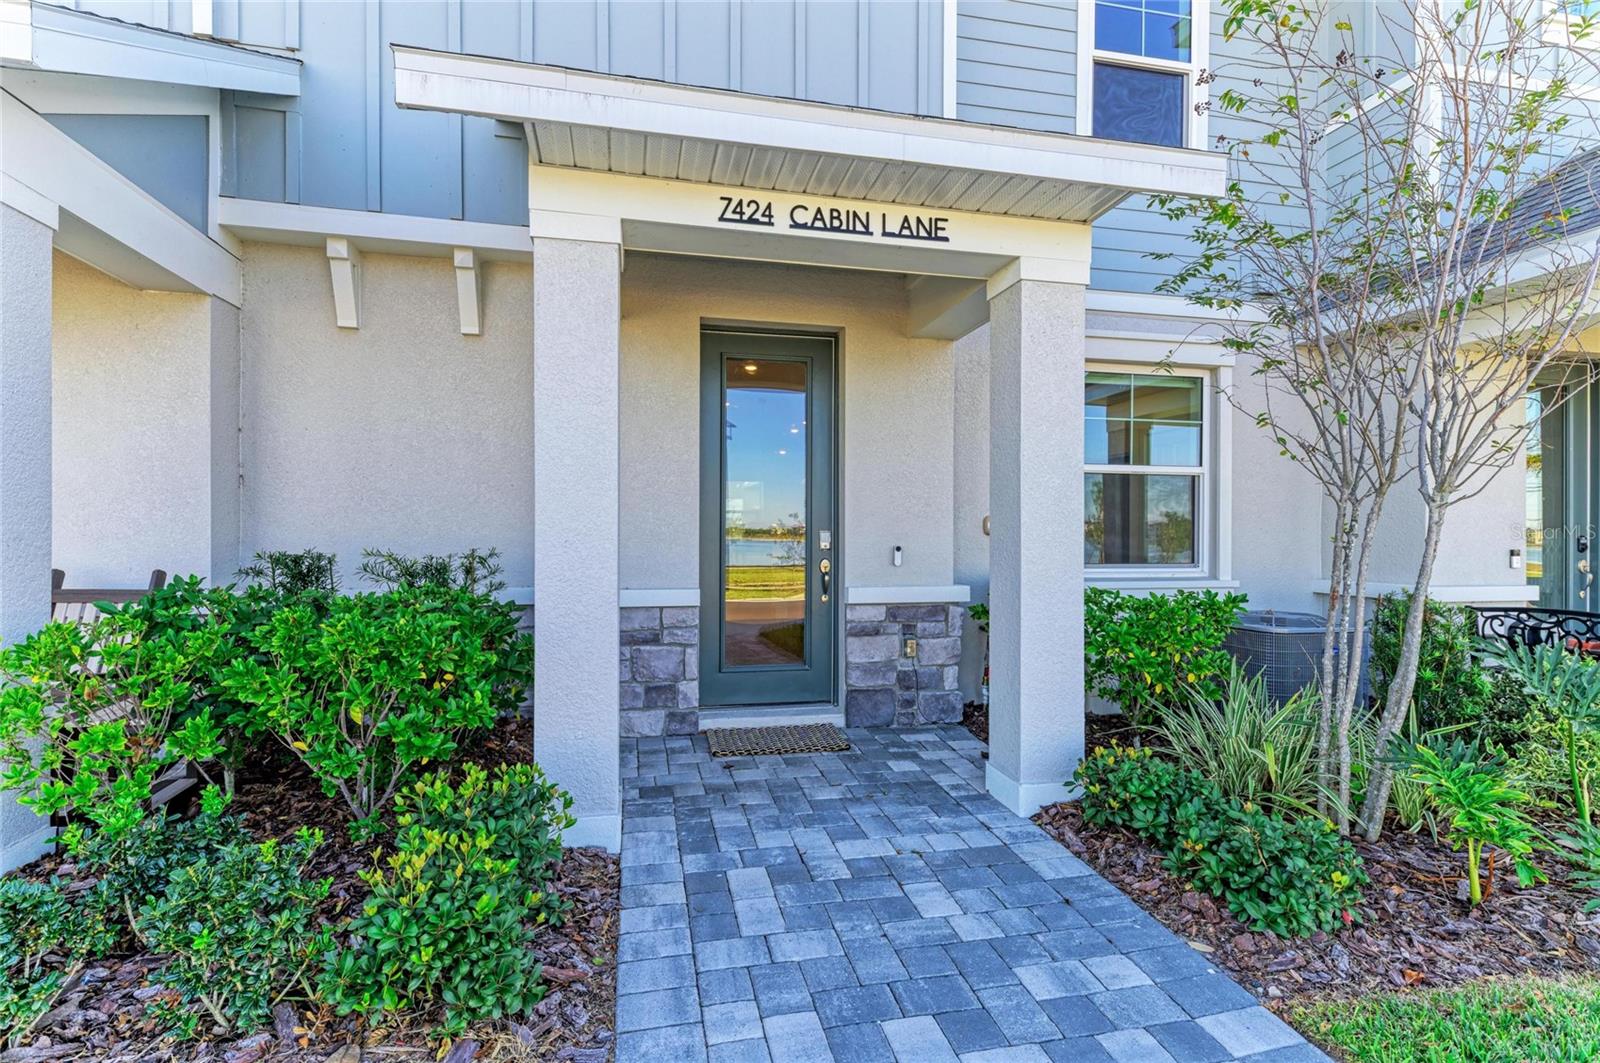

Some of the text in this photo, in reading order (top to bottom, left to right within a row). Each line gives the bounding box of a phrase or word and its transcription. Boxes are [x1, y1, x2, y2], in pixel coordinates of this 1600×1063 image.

[718, 196, 950, 242] 7424 CABIN LANE
